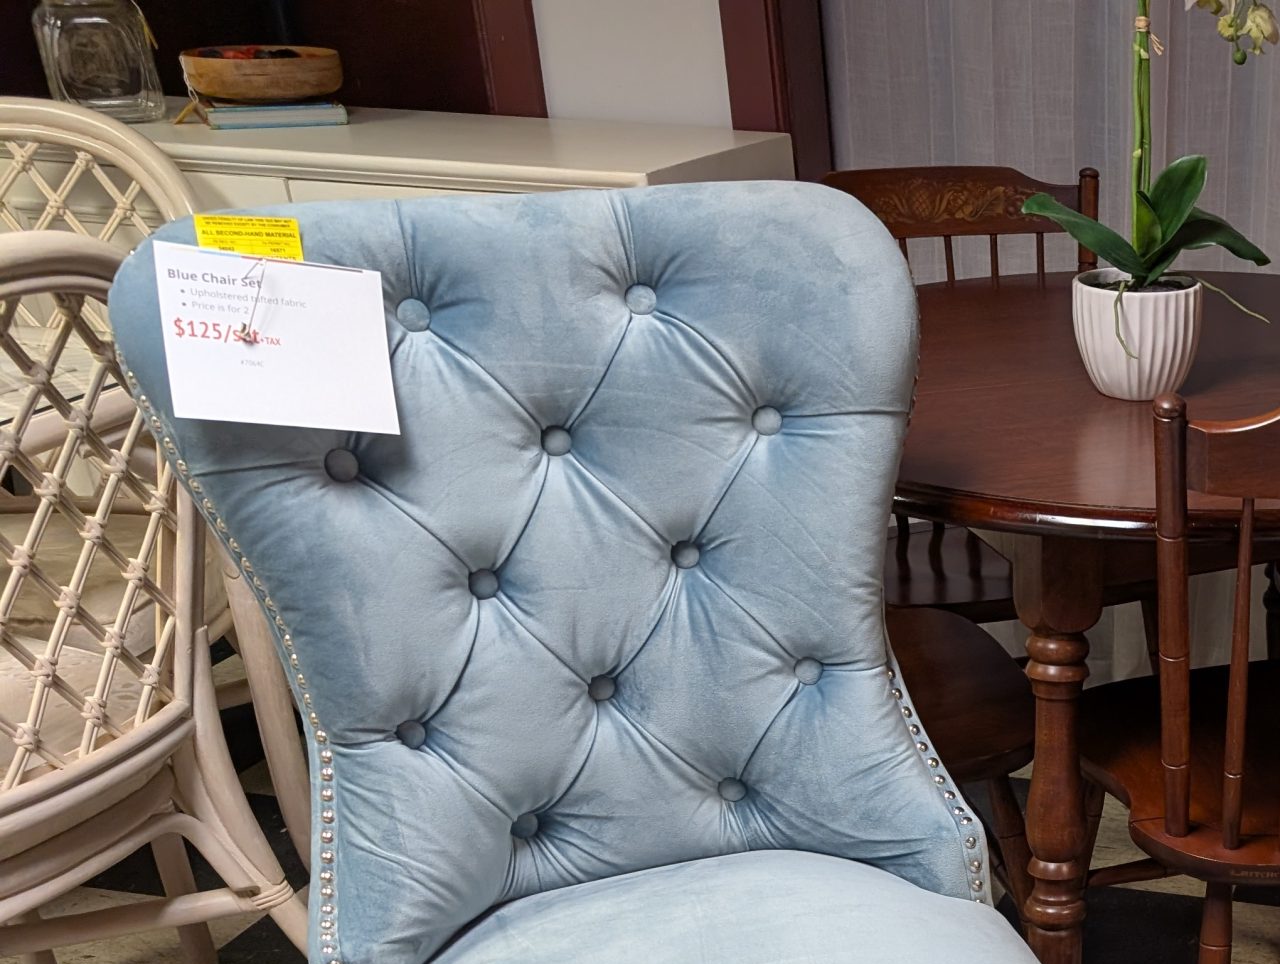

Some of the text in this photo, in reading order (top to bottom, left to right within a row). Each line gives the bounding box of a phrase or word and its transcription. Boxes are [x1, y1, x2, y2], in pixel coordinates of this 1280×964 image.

[168, 268, 262, 288] Blue Chair Set
[190, 288, 307, 308] Upholstered tufted fabric
[192, 301, 249, 314] Price is for 2
